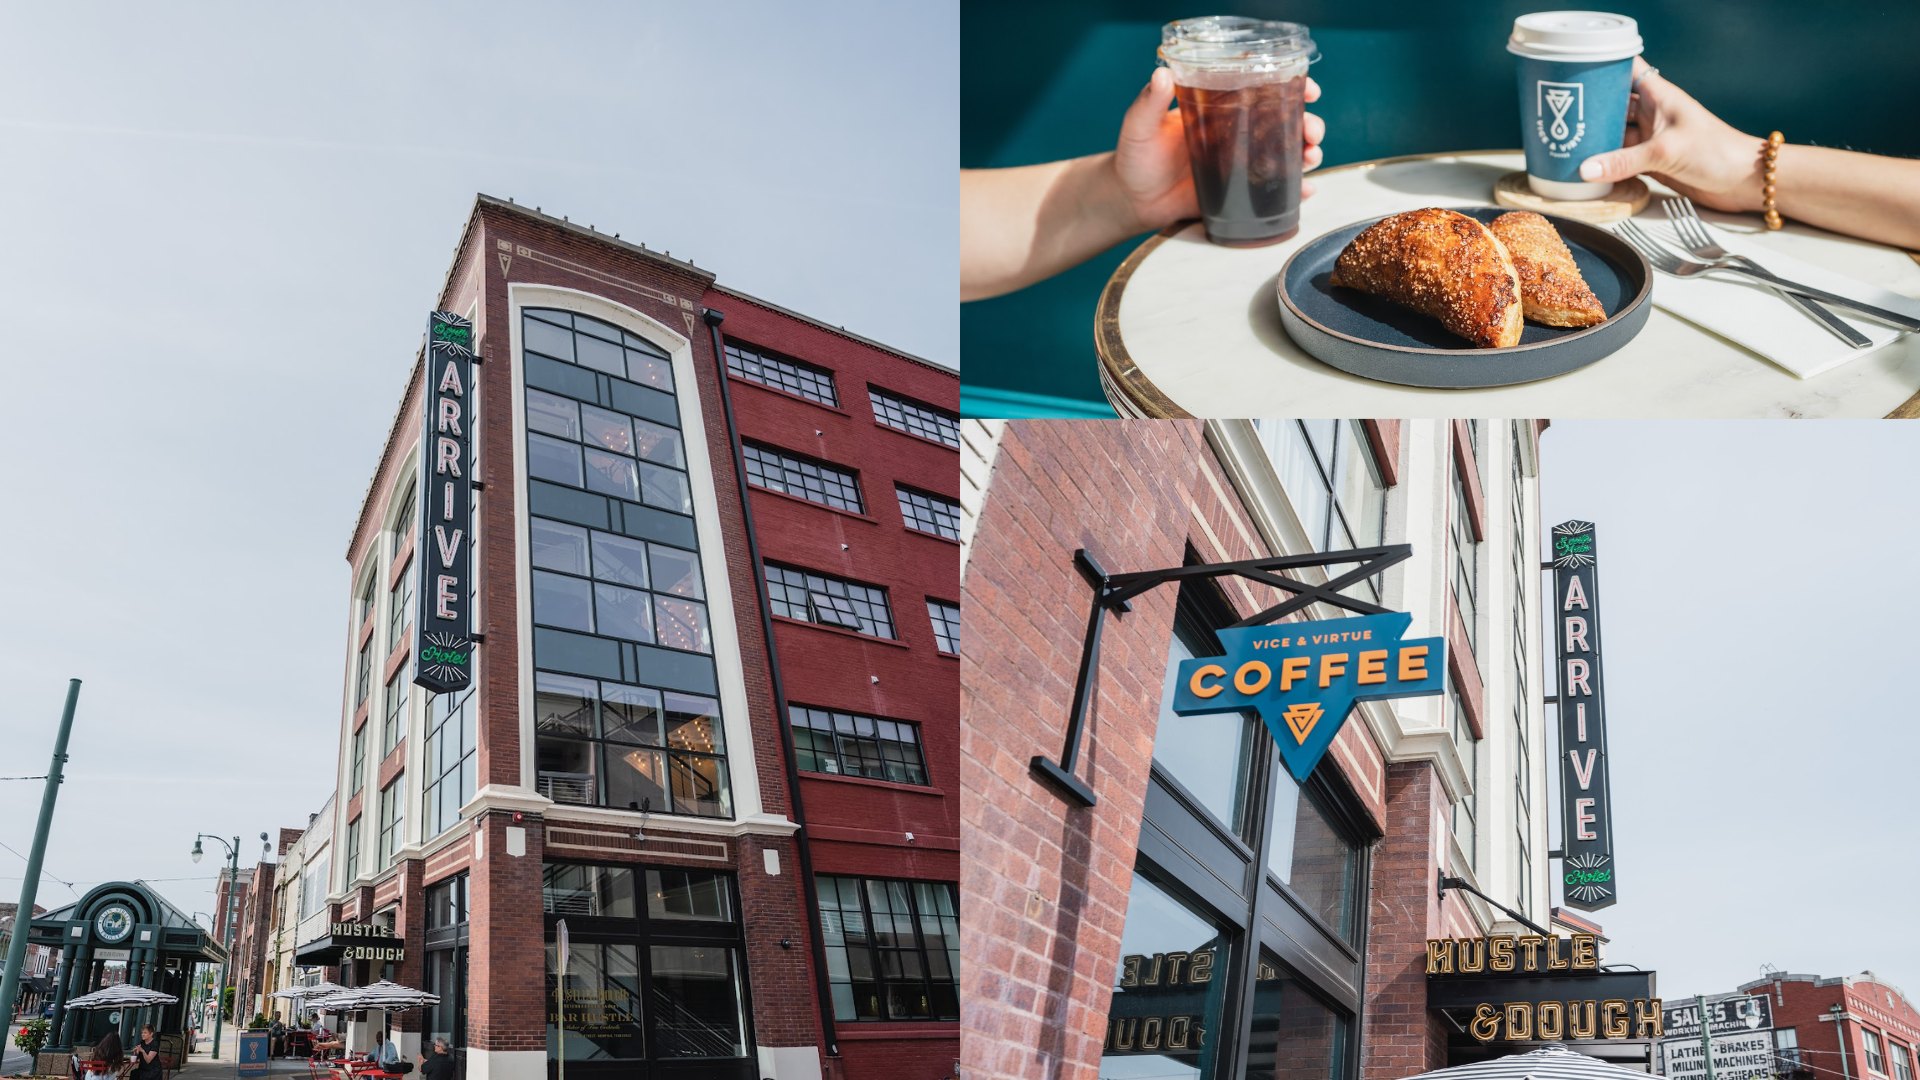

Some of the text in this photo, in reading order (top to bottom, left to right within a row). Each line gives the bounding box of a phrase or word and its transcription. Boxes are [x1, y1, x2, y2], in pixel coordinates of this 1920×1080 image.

[1559, 122, 1585, 152] VIRTUE
[434, 360, 464, 621] ARRIVE
[1555, 534, 1592, 549] South
[1253, 630, 1372, 650] VICE & VIRTUE
[421, 645, 467, 665] Hotel
[1190, 645, 1429, 698] COFFEE
[1563, 575, 1597, 842] ARRIVE
[1565, 869, 1611, 885] Hotel
[332, 923, 388, 938] HUSTLE
[1426, 933, 1597, 974] HUSTLE
[550, 1012, 634, 1022] BAR HUSTLE
[1671, 1003, 1726, 1028] SALES
[1664, 1017, 1763, 1036] WORKIN MACHIN
[1671, 1039, 1765, 1058] LATHE BRAKES
[1672, 1053, 1767, 1072] MILLIN MACHINES
